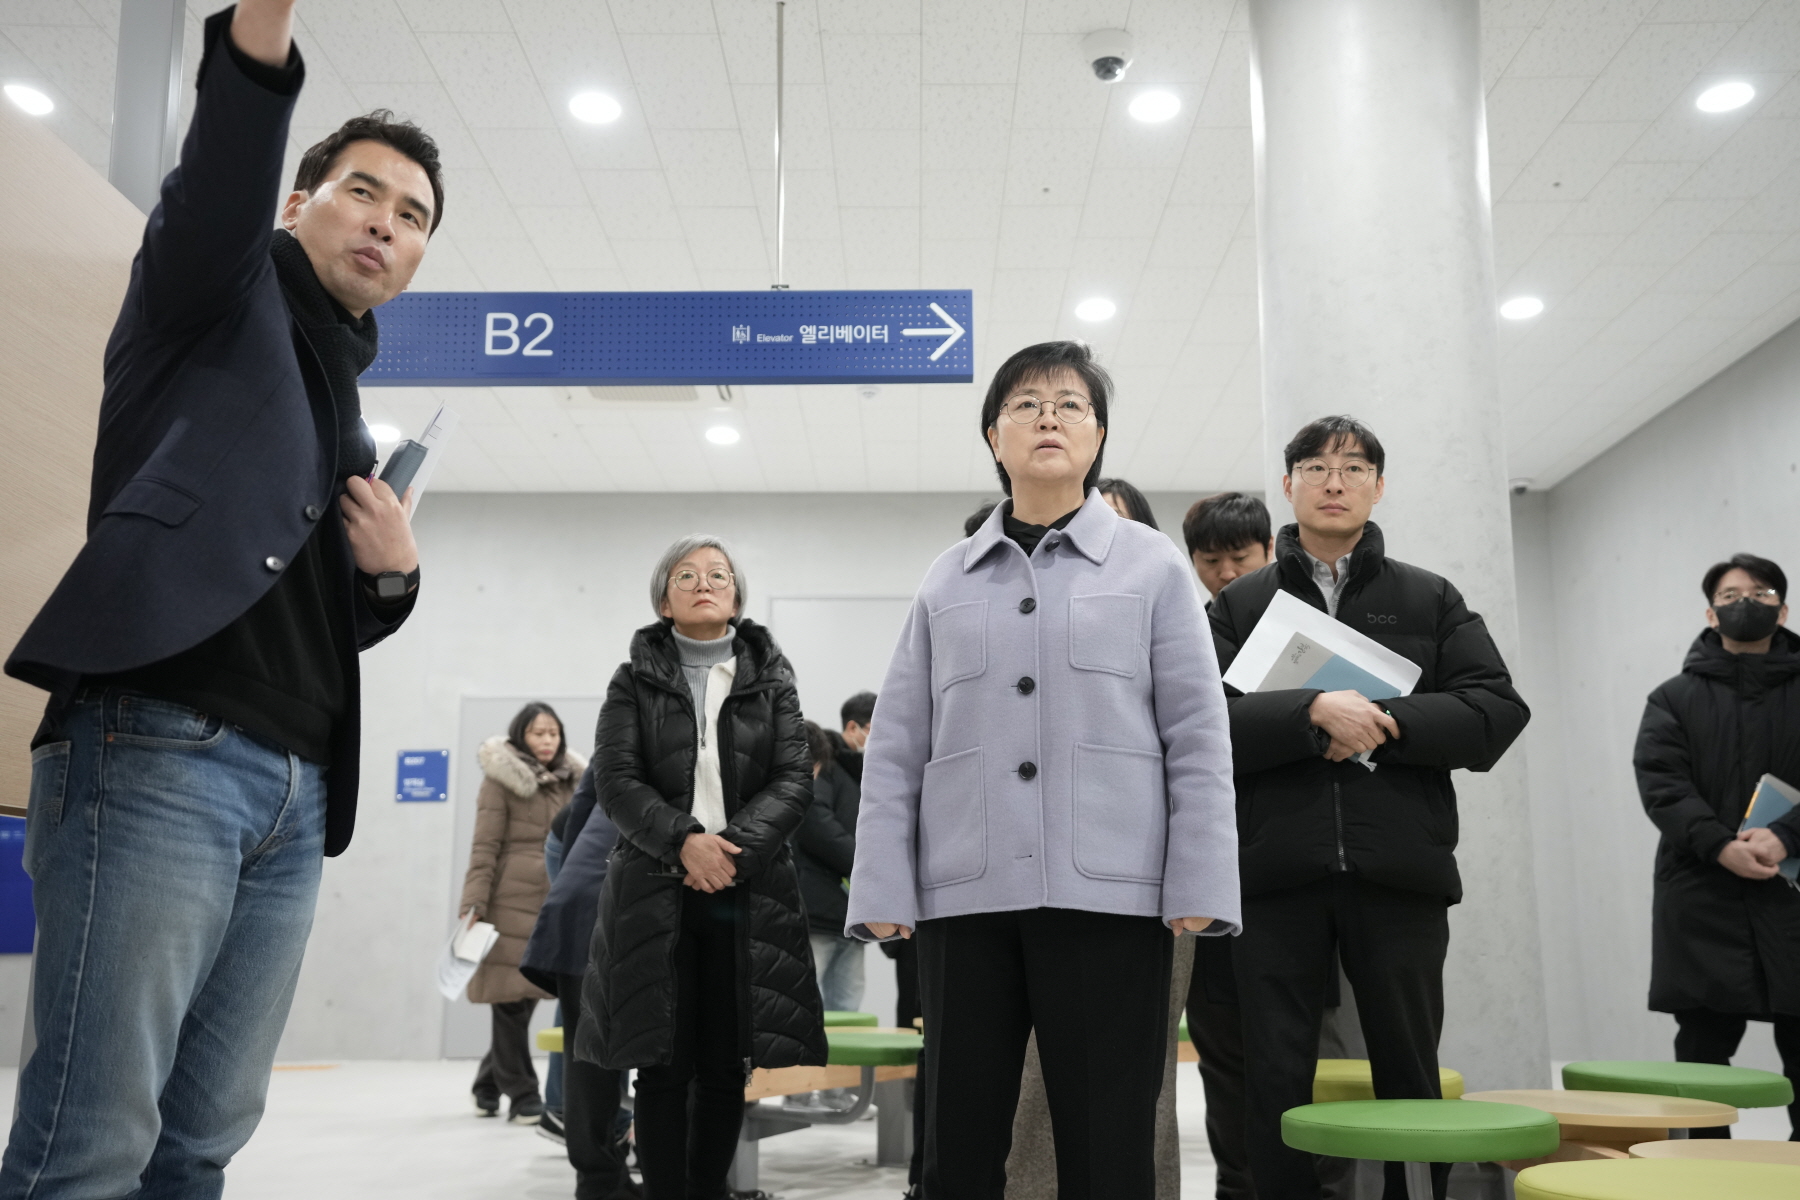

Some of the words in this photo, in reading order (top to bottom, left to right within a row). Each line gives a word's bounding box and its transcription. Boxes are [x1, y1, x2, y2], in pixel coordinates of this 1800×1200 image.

[485, 312, 554, 357] B2
[756, 333, 794, 343] Elevator
[799, 324, 889, 344] 엘리베이터
